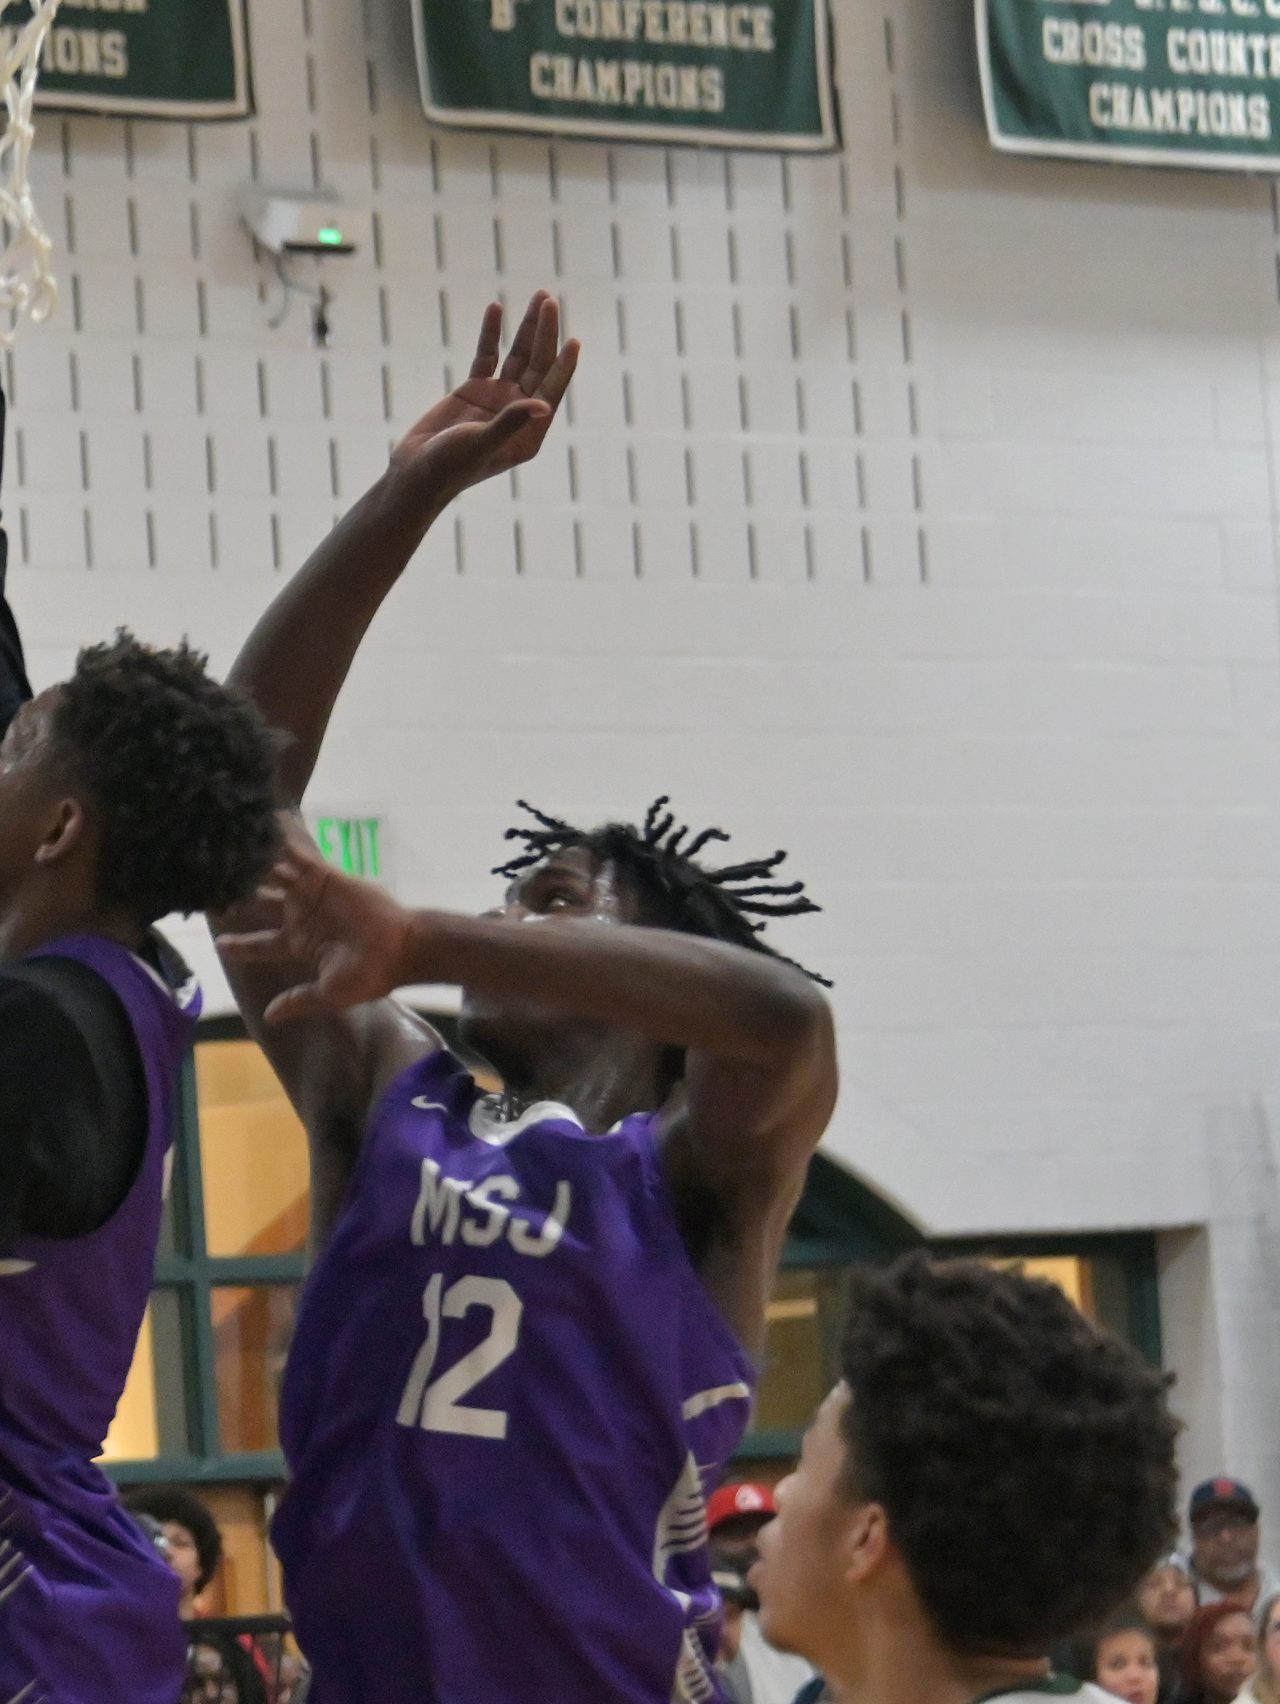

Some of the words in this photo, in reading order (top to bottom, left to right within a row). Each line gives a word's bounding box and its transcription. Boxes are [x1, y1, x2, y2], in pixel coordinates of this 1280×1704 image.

[555, 0, 775, 50] CONFERENCE
[1042, 16, 1146, 71] CROSS
[530, 51, 725, 112] CHAMPIONS
[1089, 81, 1270, 139] CHAMPIONS
[410, 1157, 570, 1258] MSJ
[395, 1272, 524, 1440] 12
